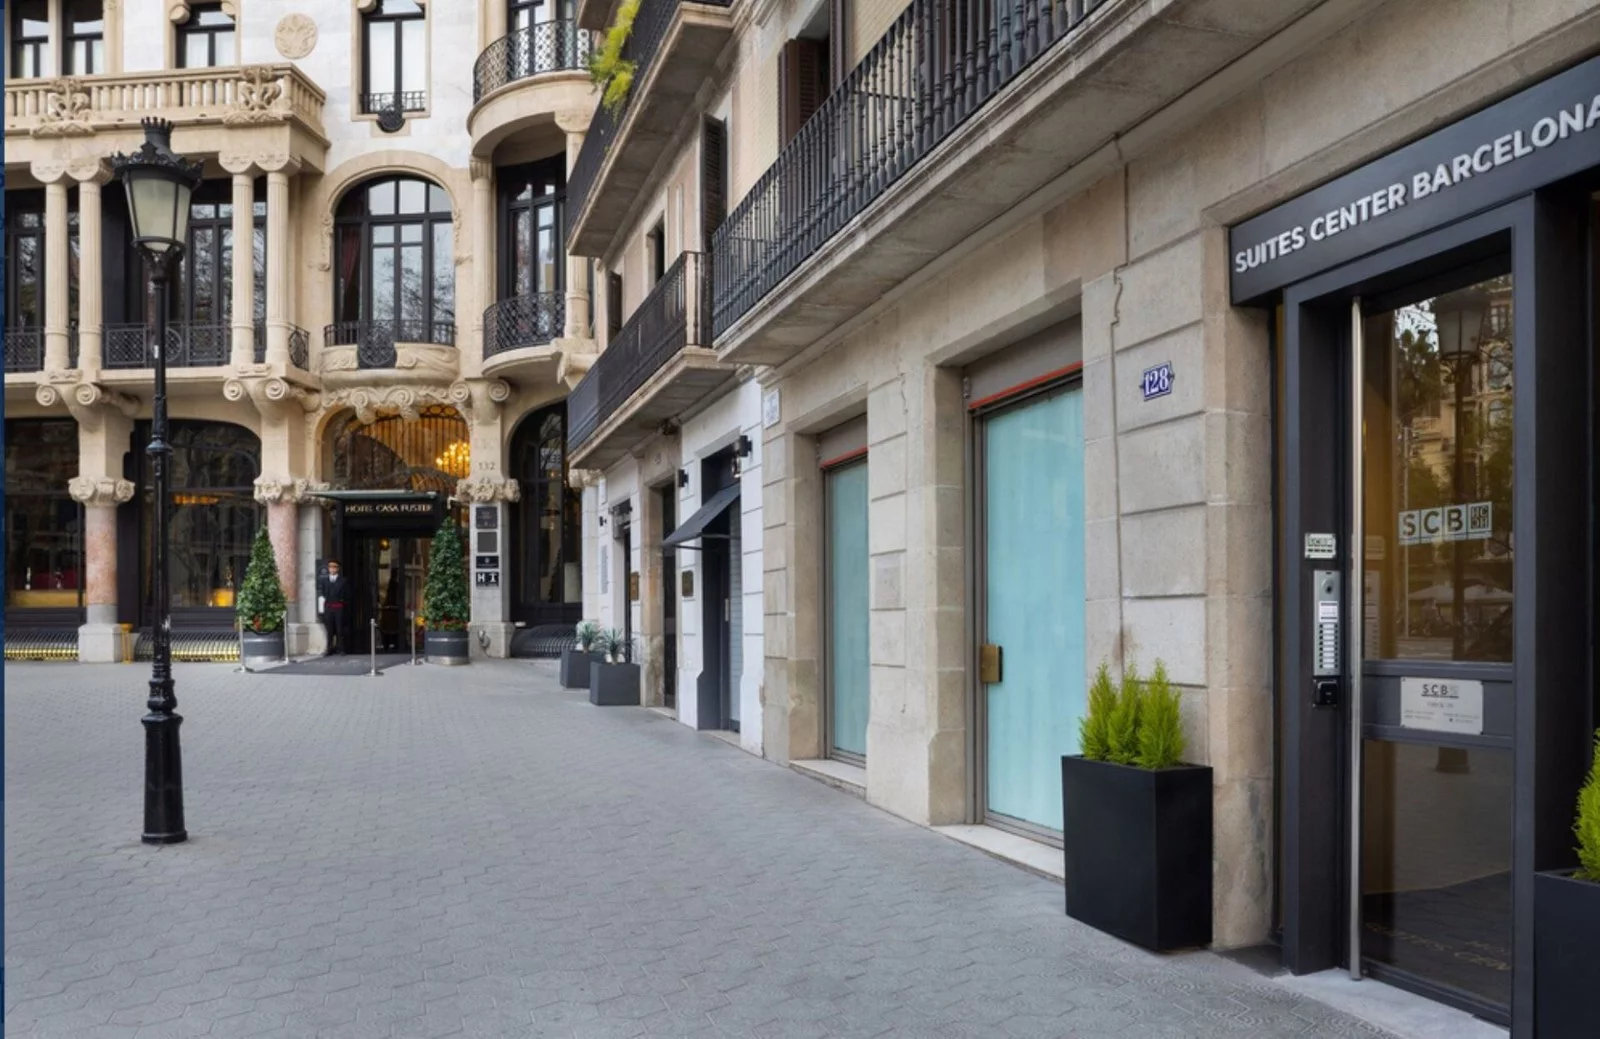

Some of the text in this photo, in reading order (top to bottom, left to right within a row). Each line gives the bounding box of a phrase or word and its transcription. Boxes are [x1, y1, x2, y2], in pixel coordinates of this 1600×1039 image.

[1235, 226, 1306, 273] SUITES
[1310, 182, 1407, 241] CENTER
[1144, 367, 1169, 396] 128
[345, 503, 433, 513] HOTEL CASA FUSTER
[1403, 508, 1463, 537] SCB
[1422, 683, 1449, 696] SCB
